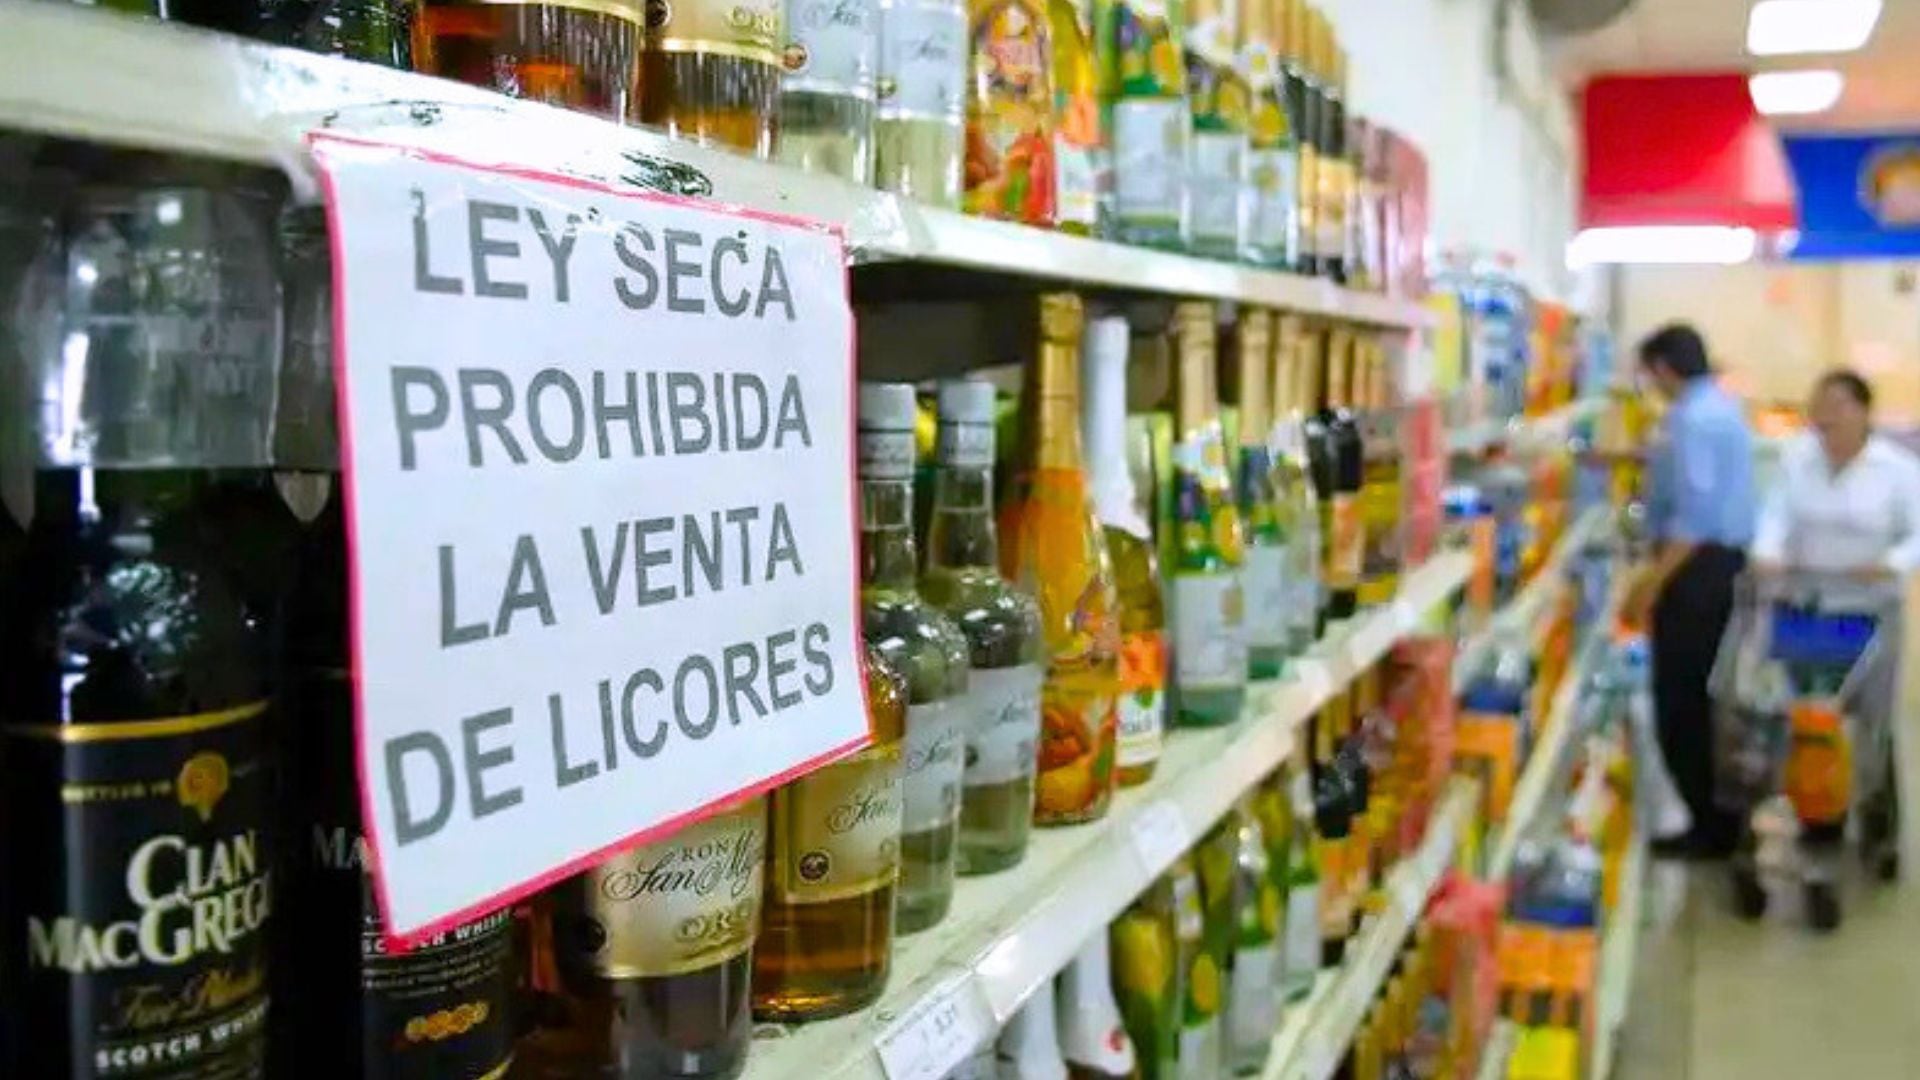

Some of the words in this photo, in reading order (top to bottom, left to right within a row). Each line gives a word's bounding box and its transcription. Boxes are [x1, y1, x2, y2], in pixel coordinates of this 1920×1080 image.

[411, 188, 578, 303] LEY
[612, 221, 797, 321] SECA
[390, 365, 812, 471] PROHIBIDA
[438, 534, 558, 648] LA
[580, 502, 805, 616] VENTA
[384, 706, 524, 848] DE
[548, 622, 836, 788] LICORES
[126, 830, 257, 908] CLAN
[95, 1033, 202, 1072] SCOTCH
